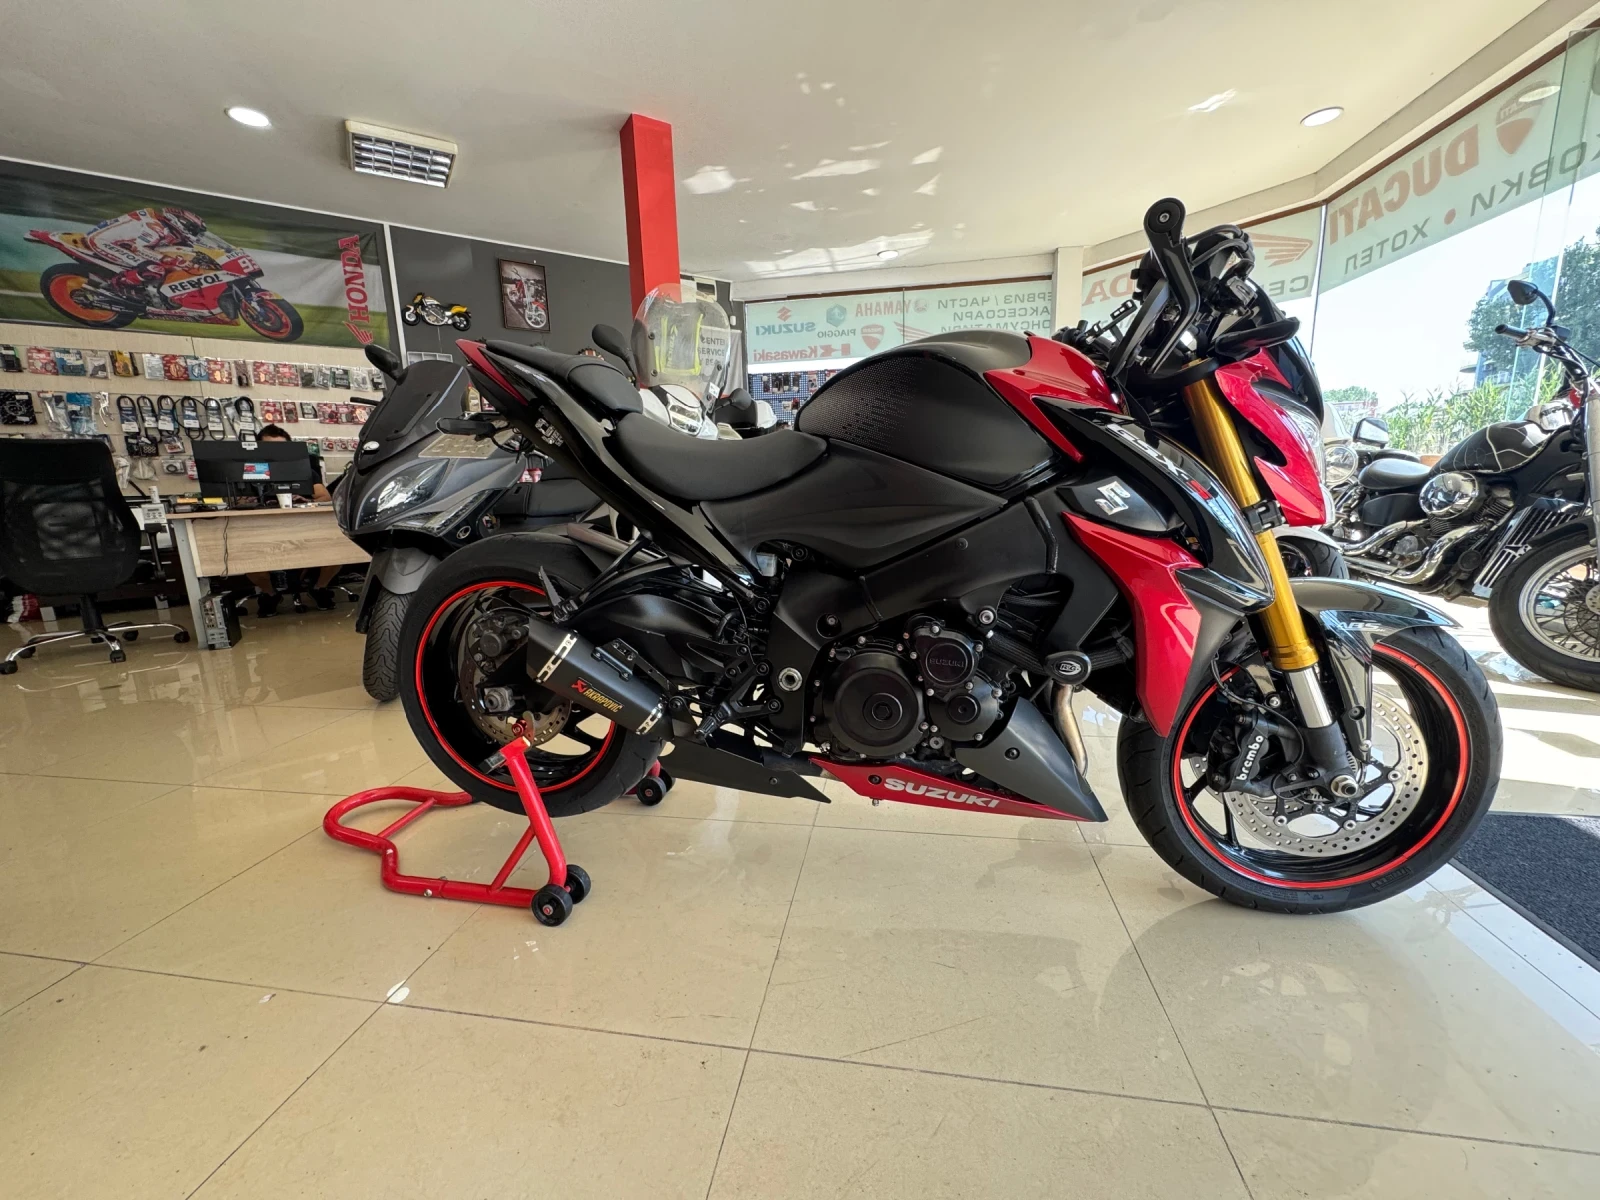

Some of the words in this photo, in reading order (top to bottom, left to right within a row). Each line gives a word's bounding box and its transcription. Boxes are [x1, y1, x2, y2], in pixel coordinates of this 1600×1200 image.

[338, 235, 370, 323] HONDA
[1337, 621, 1382, 631] ABS
[1236, 735, 1264, 781] brembo
[883, 778, 1000, 808] SUZUKI
